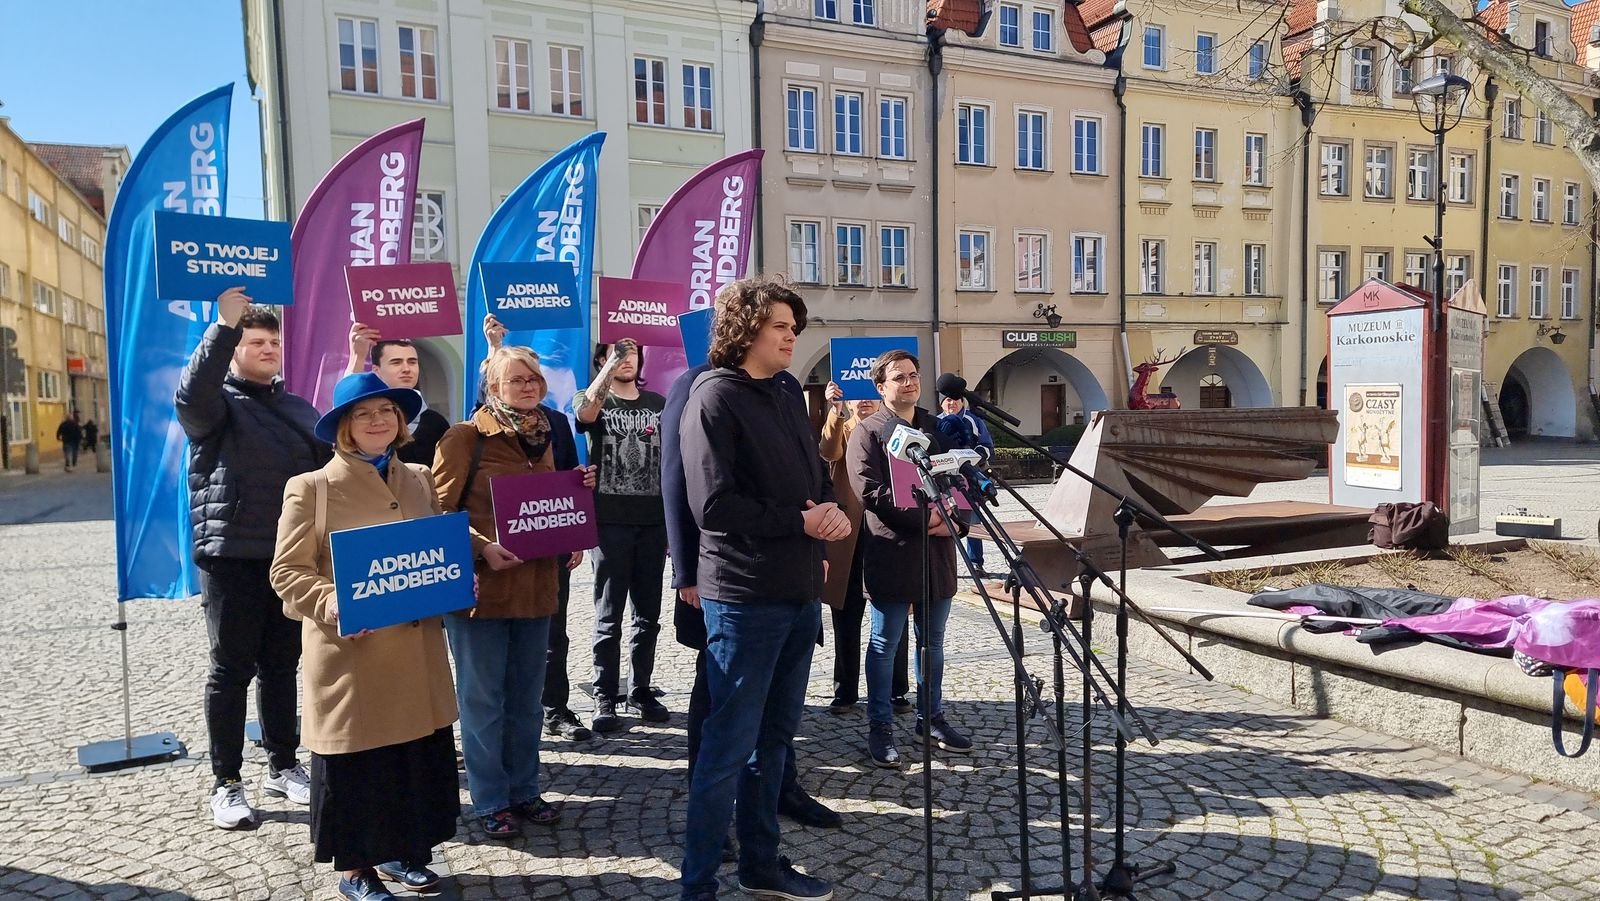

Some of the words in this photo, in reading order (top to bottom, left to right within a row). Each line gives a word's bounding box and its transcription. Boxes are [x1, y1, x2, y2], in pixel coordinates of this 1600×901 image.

[190, 122, 220, 217] BERG
[380, 152, 405, 266] DBERG
[559, 162, 585, 276] DBERG
[536, 210, 559, 262] IAN
[171, 240, 199, 256] PO
[204, 243, 279, 262] TWOJEJ
[186, 260, 267, 277] STRONIE
[689, 220, 716, 311] DRIAN
[361, 289, 384, 303] PO
[387, 286, 446, 301] TWOJEJ
[506, 283, 559, 296] ADRIAN
[1363, 290, 1380, 302] MK
[376, 301, 439, 317] STRONIE
[496, 295, 571, 310] ZANDBERG
[618, 299, 667, 314] ADRIAN
[607, 311, 677, 327] ZANDBERG
[1348, 320, 1391, 333] MUZEUM
[1006, 332, 1038, 342] CLUB
[1039, 332, 1074, 342] SUSHI
[1336, 331, 1416, 346] Karkonoskie
[1366, 399, 1397, 409] CZASY
[518, 496, 575, 517] ADRIAN
[507, 511, 587, 534] ZANDBERG
[367, 547, 446, 578] ADRIAN
[351, 563, 461, 601] ZANDBERG
